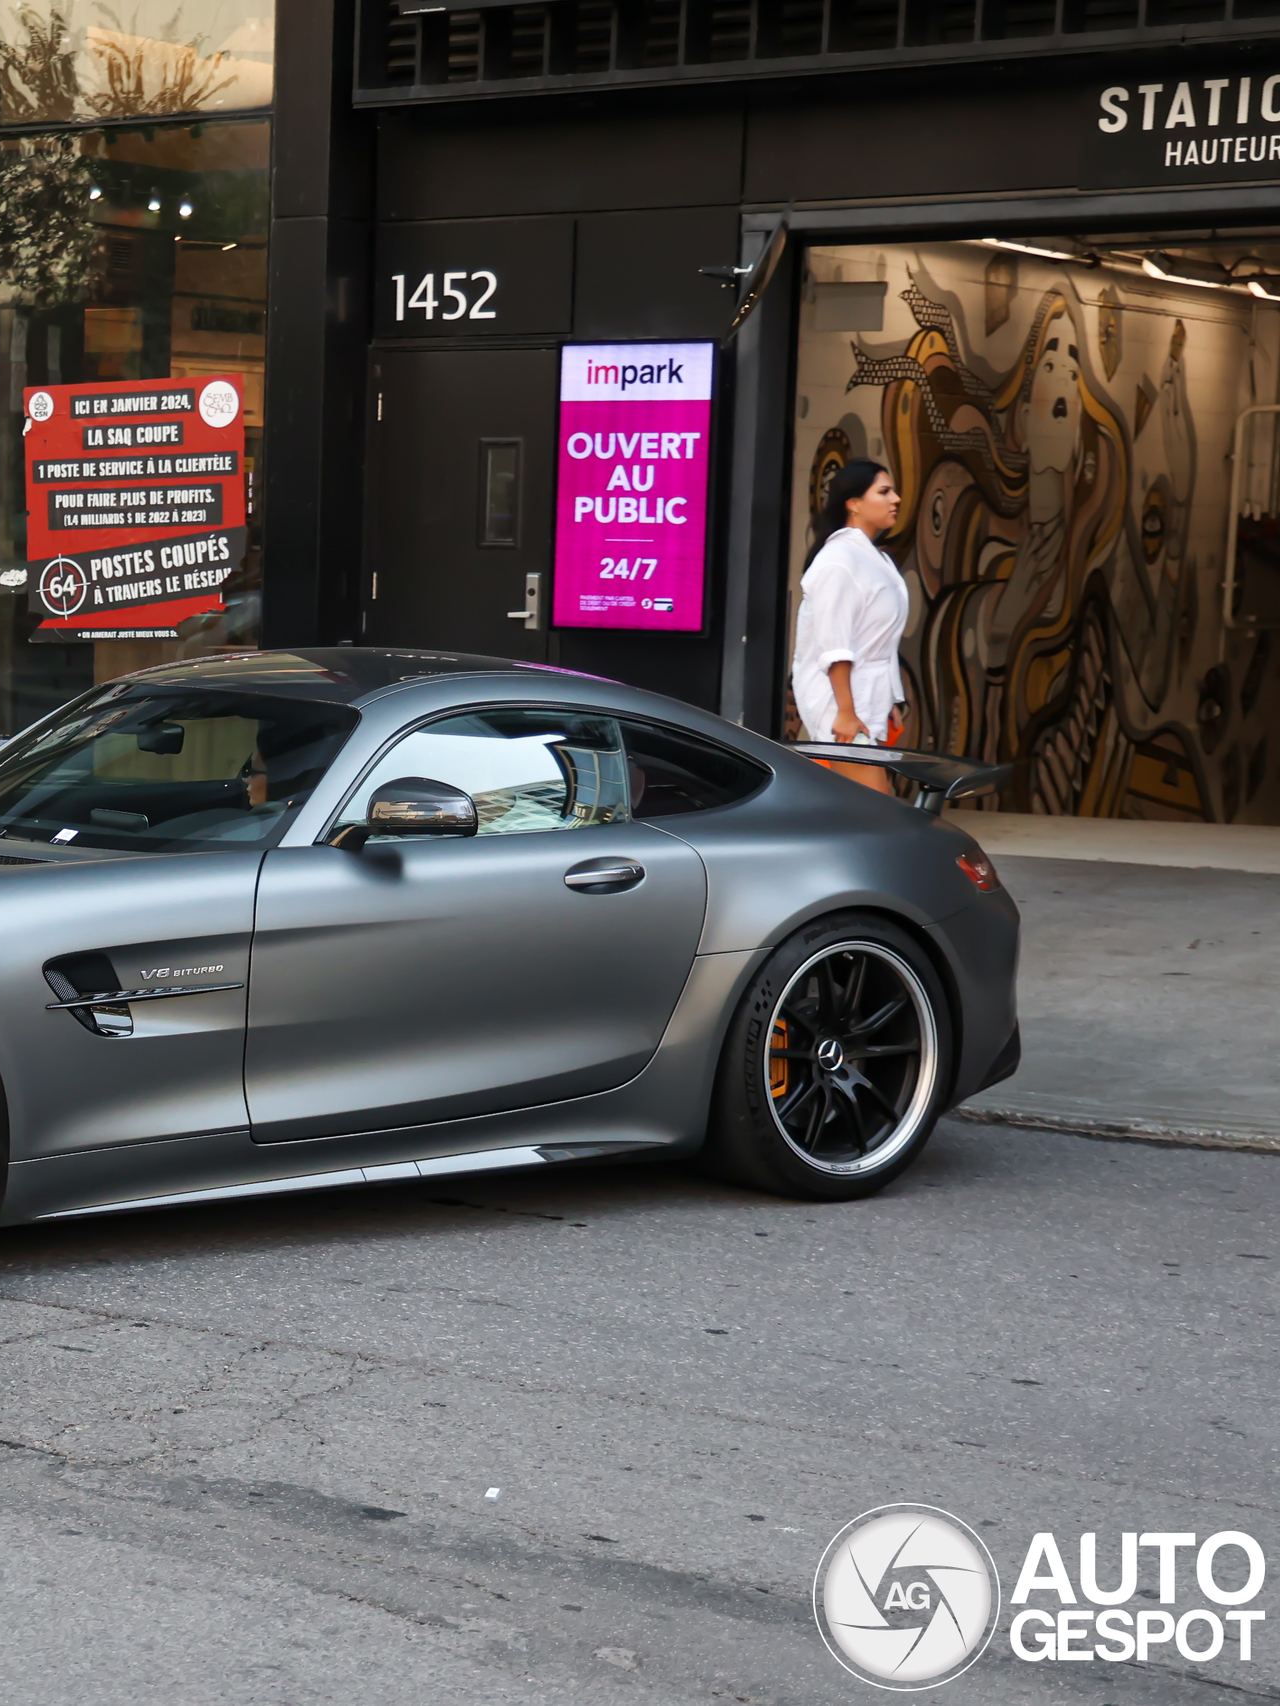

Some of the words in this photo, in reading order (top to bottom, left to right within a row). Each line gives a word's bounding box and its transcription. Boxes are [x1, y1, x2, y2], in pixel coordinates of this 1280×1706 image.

[391, 271, 498, 321] 1452
[587, 358, 684, 391] impark
[34, 410, 48, 418] CSN
[75, 401, 90, 415] ICI
[94, 400, 108, 414] EN
[112, 397, 157, 413] JANVIER
[161, 395, 191, 411] 2024,
[88, 429, 103, 446] LA
[107, 427, 131, 446] SAQ
[136, 425, 178, 444] COUPE
[566, 432, 701, 460] OUVERT
[38, 465, 44, 478] 1
[47, 463, 80, 478] POSTE
[83, 462, 96, 477] DE
[99, 460, 144, 476] SERVICE
[147, 457, 155, 474] À
[158, 459, 172, 473] LA
[175, 454, 232, 473] CLIENTÈLE
[606, 465, 655, 492] AU
[55, 494, 83, 508] POUR
[87, 493, 116, 507] FAIRE
[120, 492, 146, 506] PLUS
[150, 491, 164, 505] DE
[167, 489, 215, 504] PROFITS.
[574, 496, 688, 525] PUBLIC
[81, 512, 125, 525] MILLIARDS
[127, 512, 133, 524] $
[135, 511, 146, 523] DE
[149, 511, 170, 523] 2022
[172, 509, 178, 522] À
[181, 509, 207, 523] 2023)
[91, 549, 155, 581] POSTES
[160, 534, 230, 569] COUPÉS
[599, 557, 658, 581] 24/7
[49, 574, 77, 599] 64
[94, 585, 103, 605] À
[106, 580, 162, 603] TRAVERS
[166, 577, 181, 594] LE
[140, 967, 170, 980] V8
[173, 964, 224, 978] BITURBO
